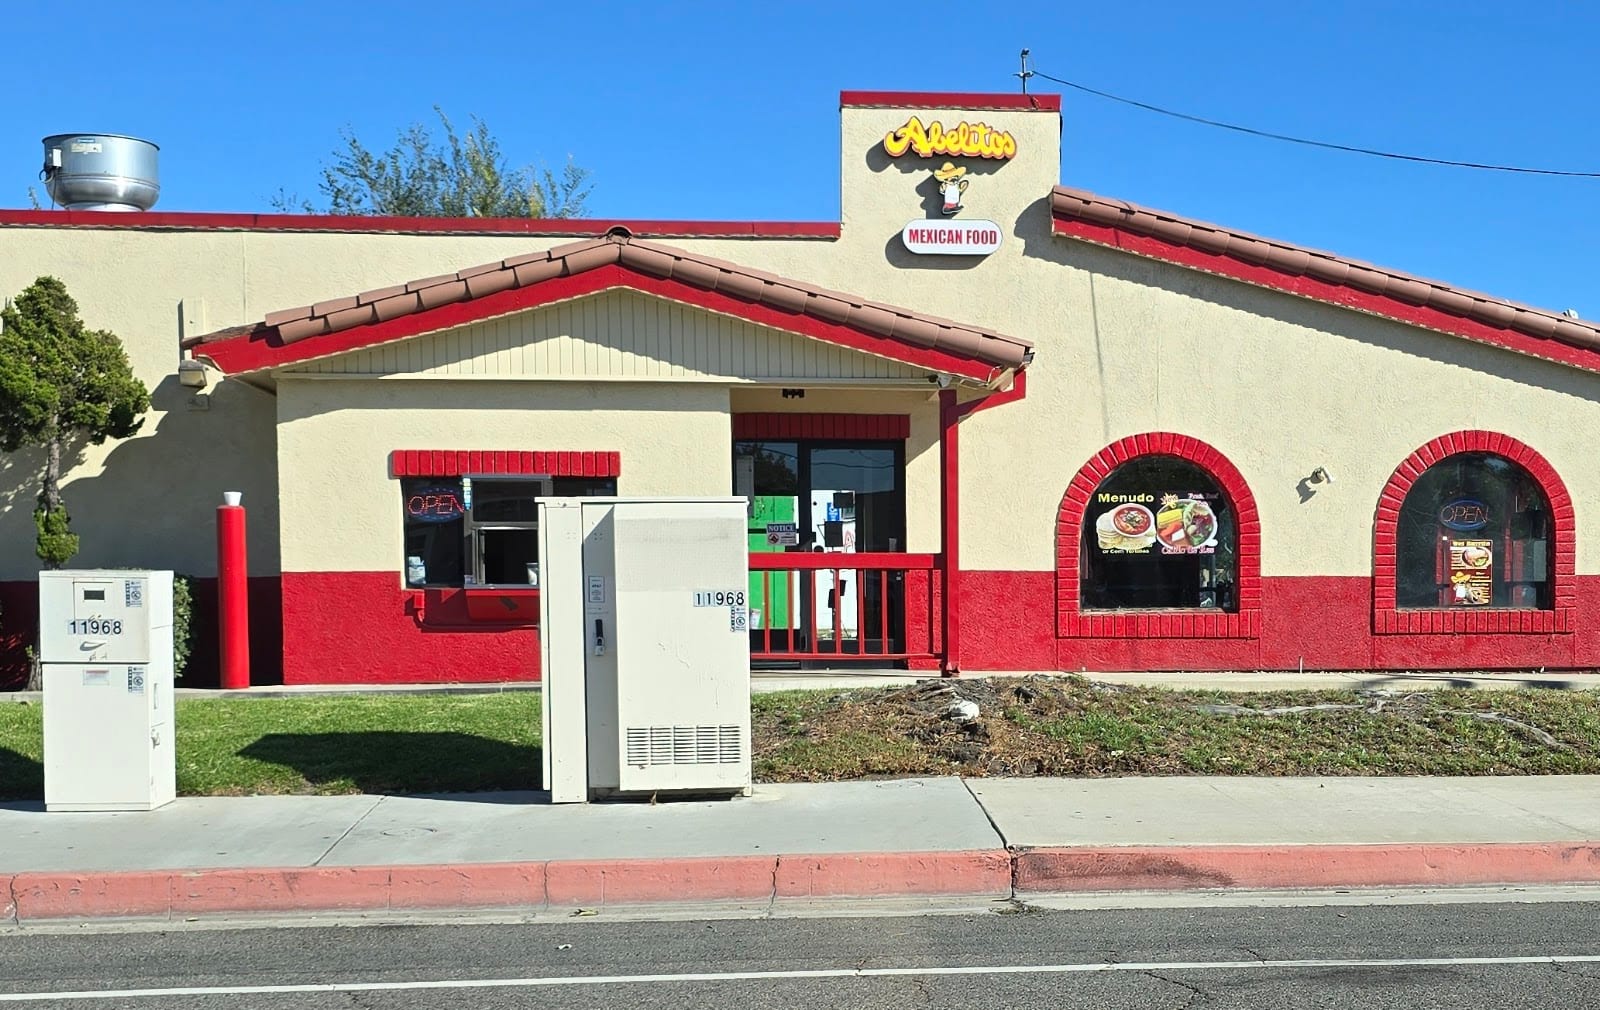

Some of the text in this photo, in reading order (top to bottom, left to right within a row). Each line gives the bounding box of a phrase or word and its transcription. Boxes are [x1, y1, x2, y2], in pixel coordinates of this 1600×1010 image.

[884, 116, 1017, 159] Abelitos
[908, 229, 997, 245] MEXICAN FOOD
[408, 494, 465, 515] OPEN
[1098, 493, 1154, 503] Menudo
[1440, 505, 1489, 524] OPEN
[768, 524, 796, 532] NOTICE
[696, 592, 745, 606] 11968
[69, 620, 122, 634] 11968
